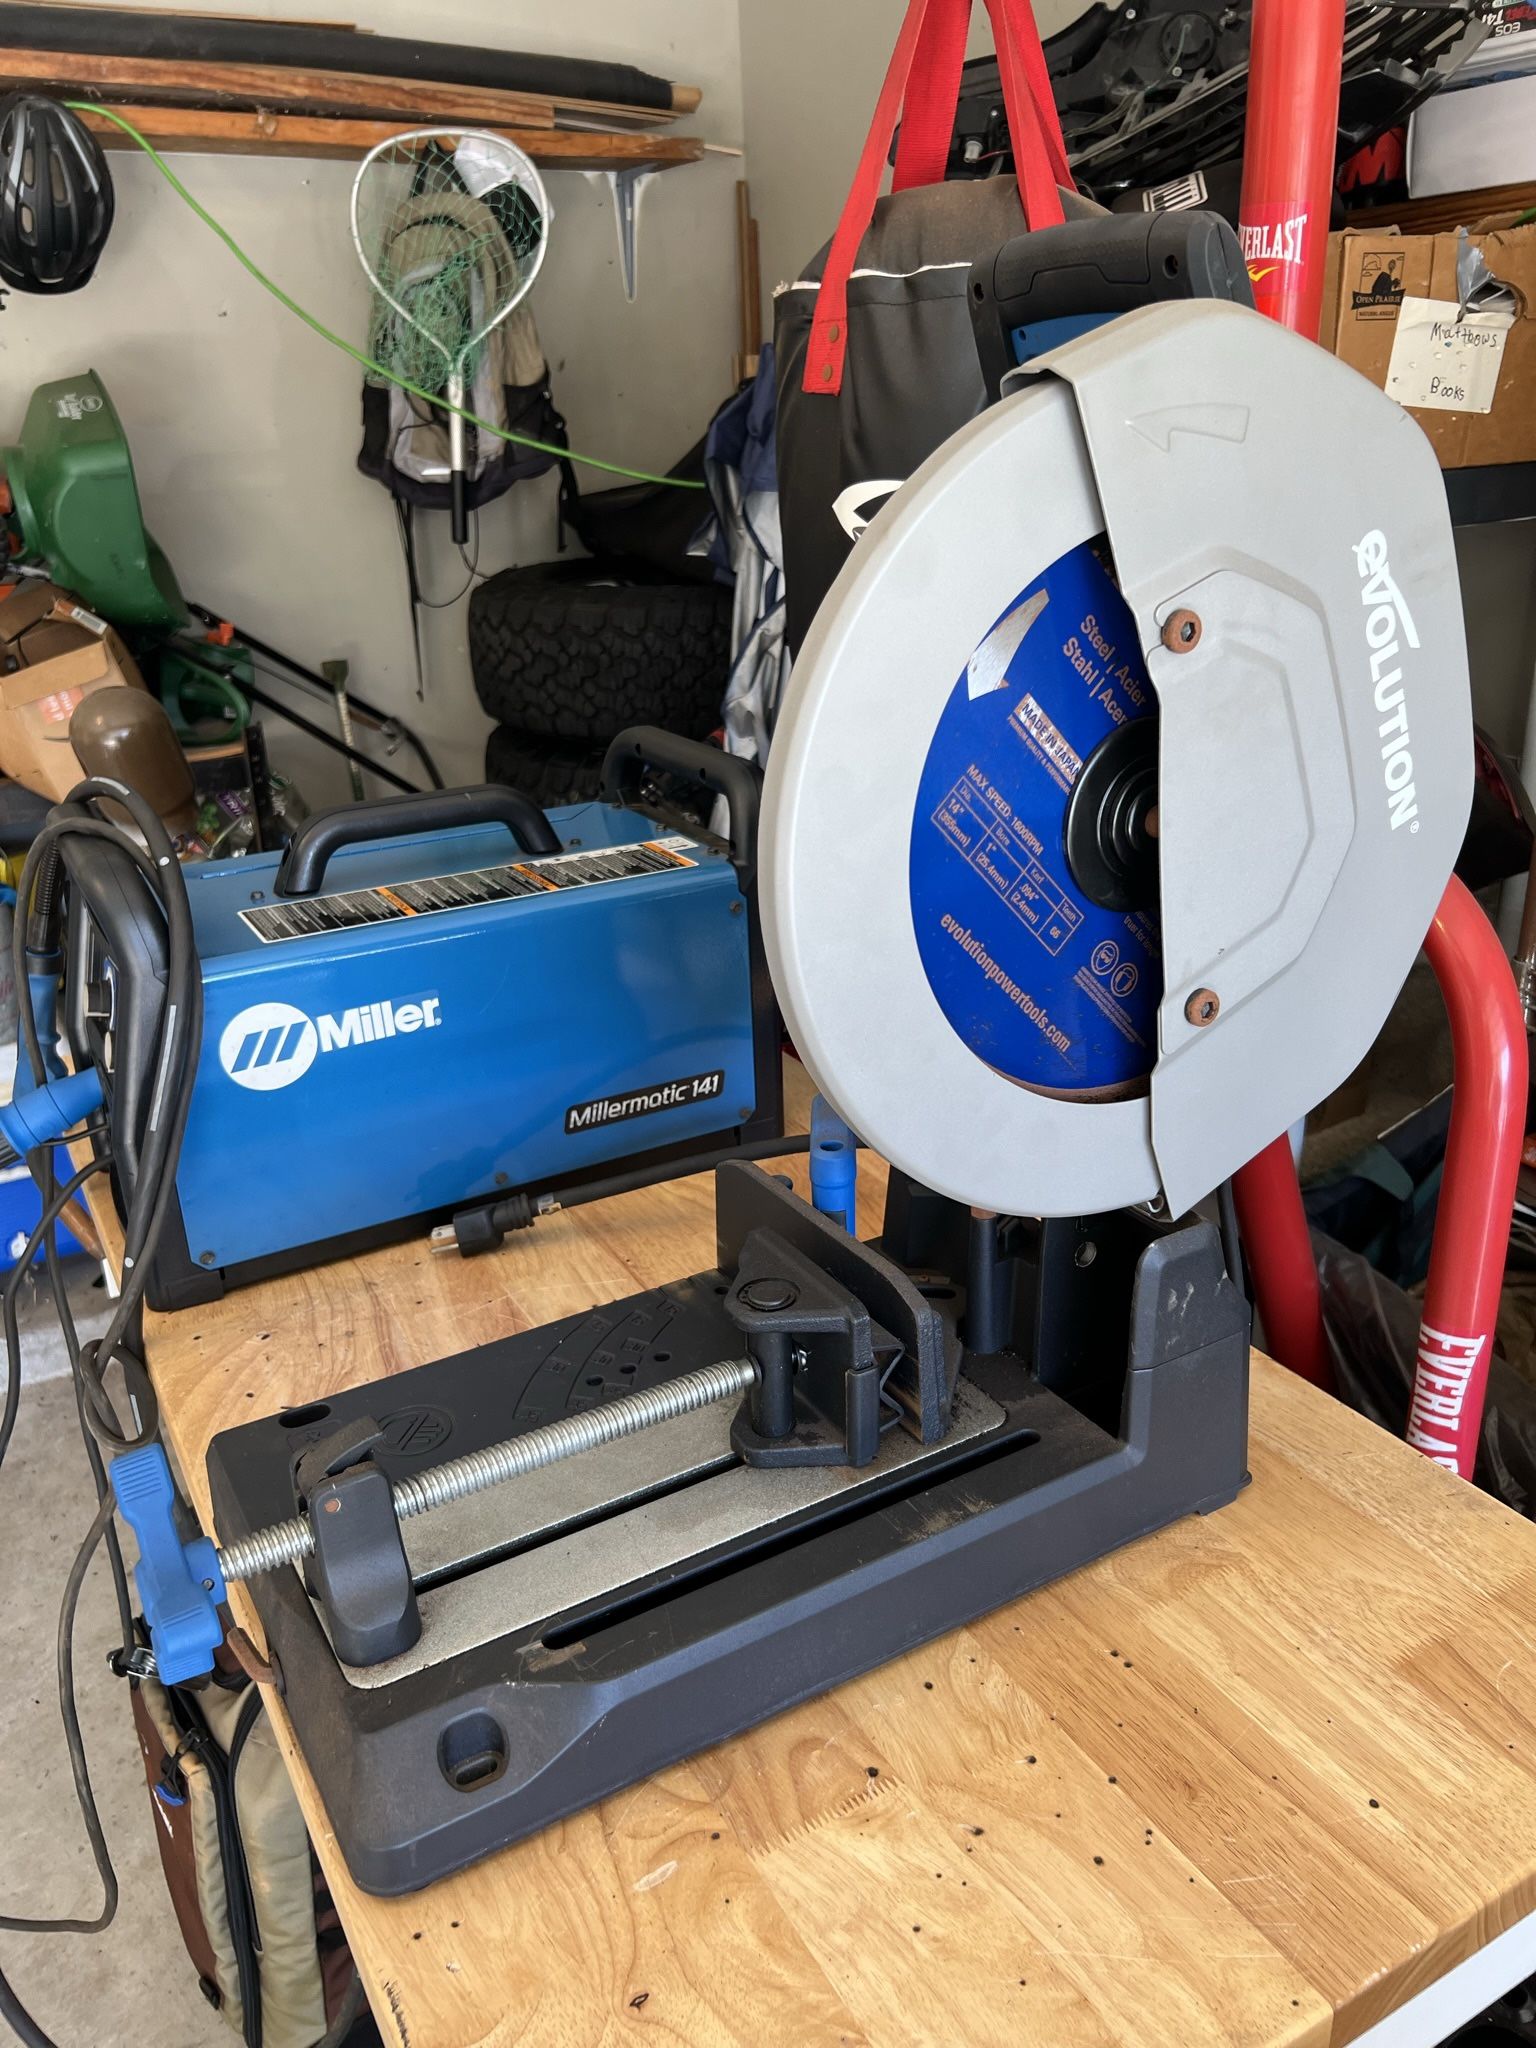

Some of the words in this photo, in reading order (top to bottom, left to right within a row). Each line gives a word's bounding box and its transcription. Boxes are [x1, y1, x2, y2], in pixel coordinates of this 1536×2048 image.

[1495, 21, 1521, 37] EOS
[1238, 213, 1307, 265] VERLAST
[1355, 294, 1374, 305] OPEN
[1430, 376, 1465, 401] Books
[1062, 637, 1099, 686] Stahl
[1097, 687, 1128, 725] Acer
[1080, 614, 1116, 662] Steel
[1114, 665, 1146, 707] Acier
[1021, 703, 1048, 738] MADE
[1045, 733, 1058, 749] IN
[966, 764, 990, 791] MAX
[985, 786, 1012, 820] SPEED:
[995, 827, 1011, 847] Bore
[940, 913, 1071, 1053] evolutionpowertools.com
[316, 997, 441, 1053] Miller
[569, 1084, 688, 1129] Millermatic
[692, 1074, 720, 1098] 141
[1405, 1322, 1487, 1474] EVERLA
